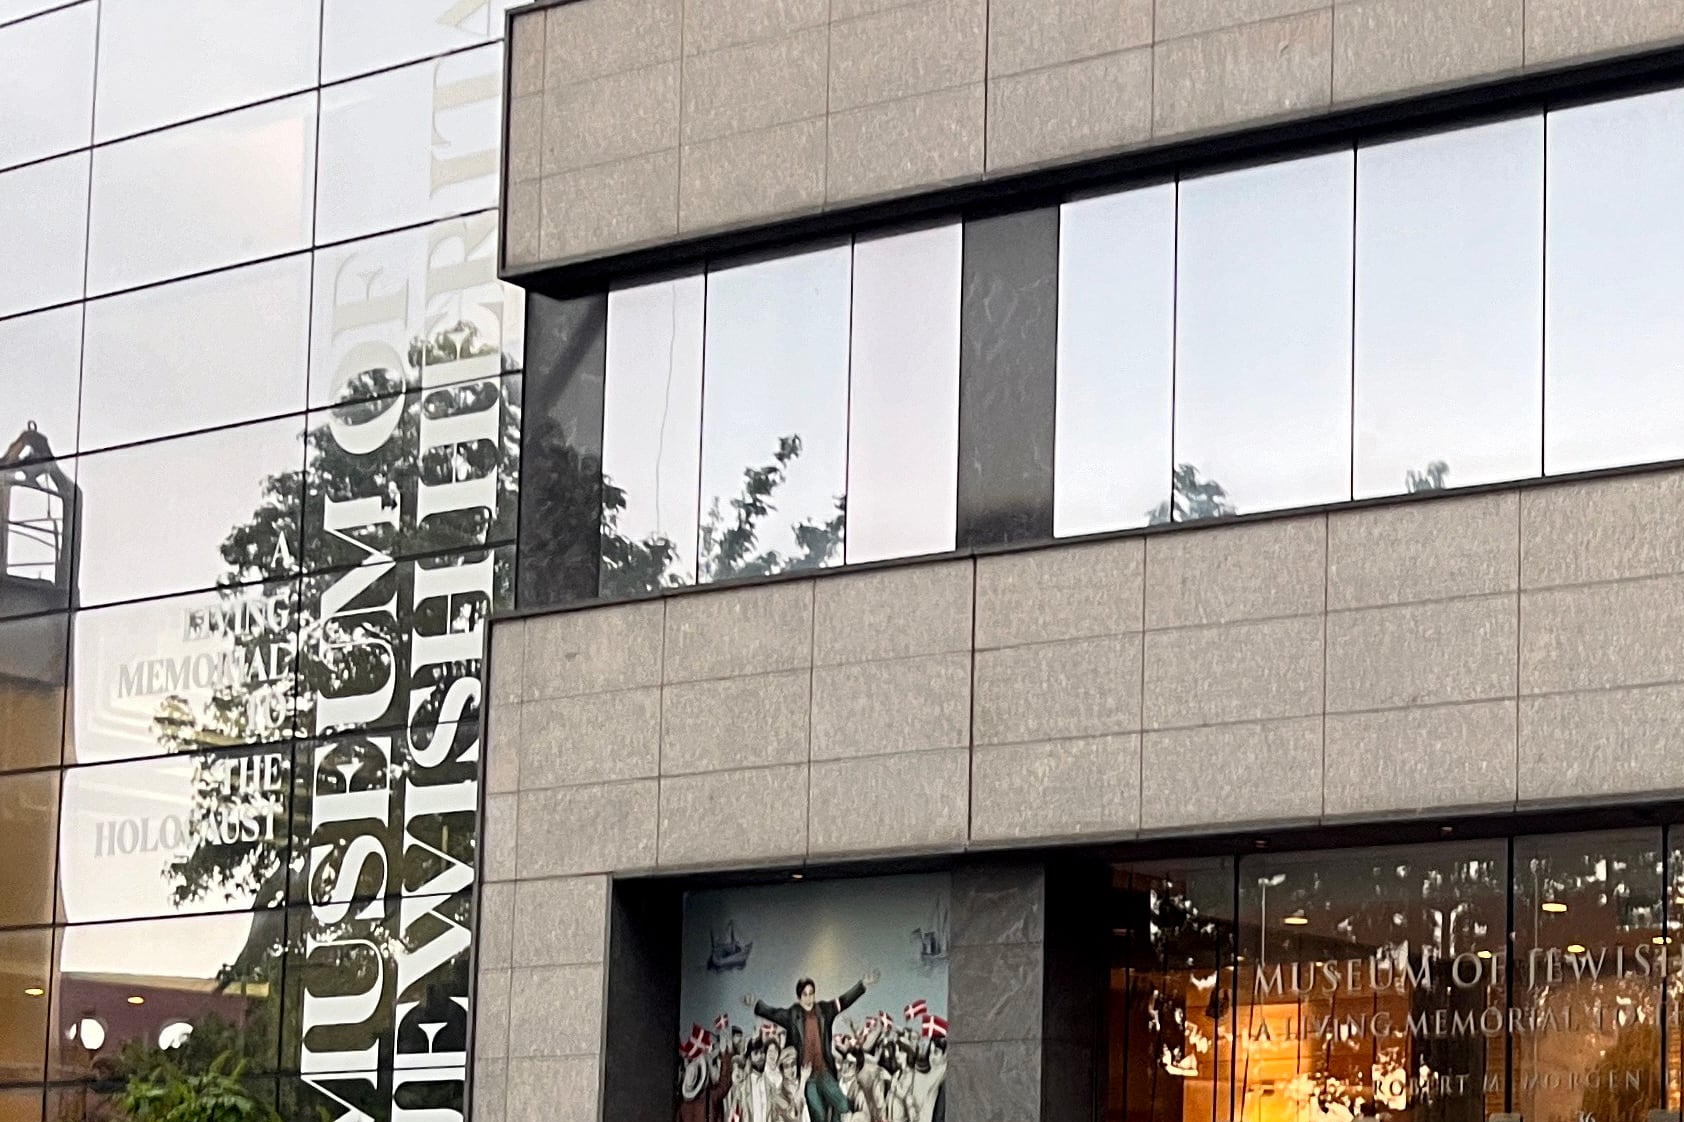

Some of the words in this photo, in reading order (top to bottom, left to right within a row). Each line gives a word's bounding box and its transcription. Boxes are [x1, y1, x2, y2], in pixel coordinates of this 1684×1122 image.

[329, 250, 407, 454] OF
[270, 530, 295, 568] A
[182, 594, 291, 642] LIVING
[117, 643, 290, 698] MEMORIAL
[218, 753, 283, 794] THE
[1254, 953, 1432, 996] MUSEUM
[1452, 950, 1507, 988] OF
[1254, 1018, 1271, 1041] A
[1285, 1012, 1391, 1042] LIVING
[1405, 1005, 1582, 1036] MEMORIAL
